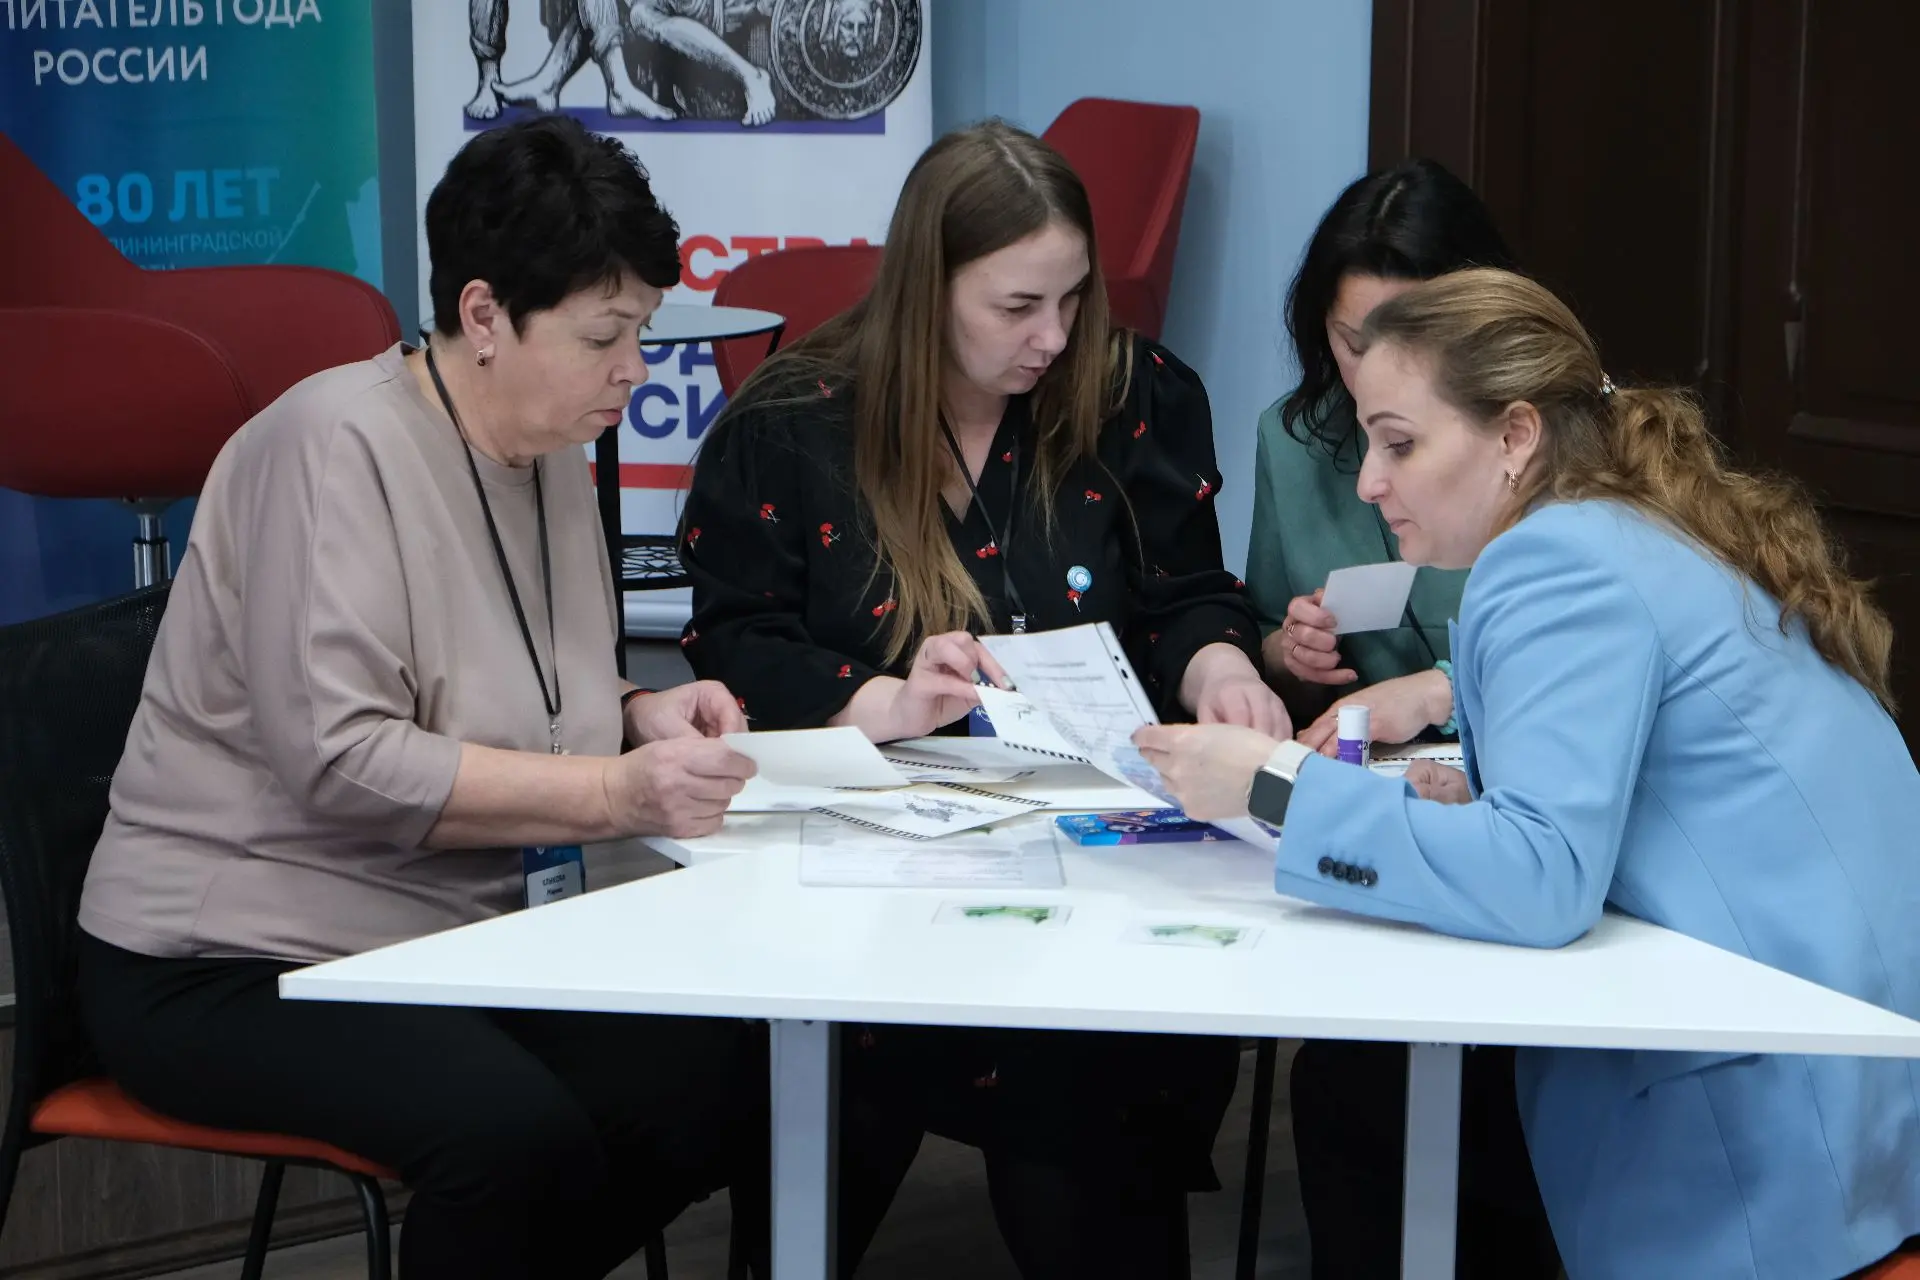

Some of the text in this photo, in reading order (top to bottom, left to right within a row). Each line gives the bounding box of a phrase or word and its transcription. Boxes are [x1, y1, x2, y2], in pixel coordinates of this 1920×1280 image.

[215, 0, 323, 29] ГОДА
[33, 45, 208, 86] РОССИИ
[76, 167, 281, 226] 80 ЛЕТ
